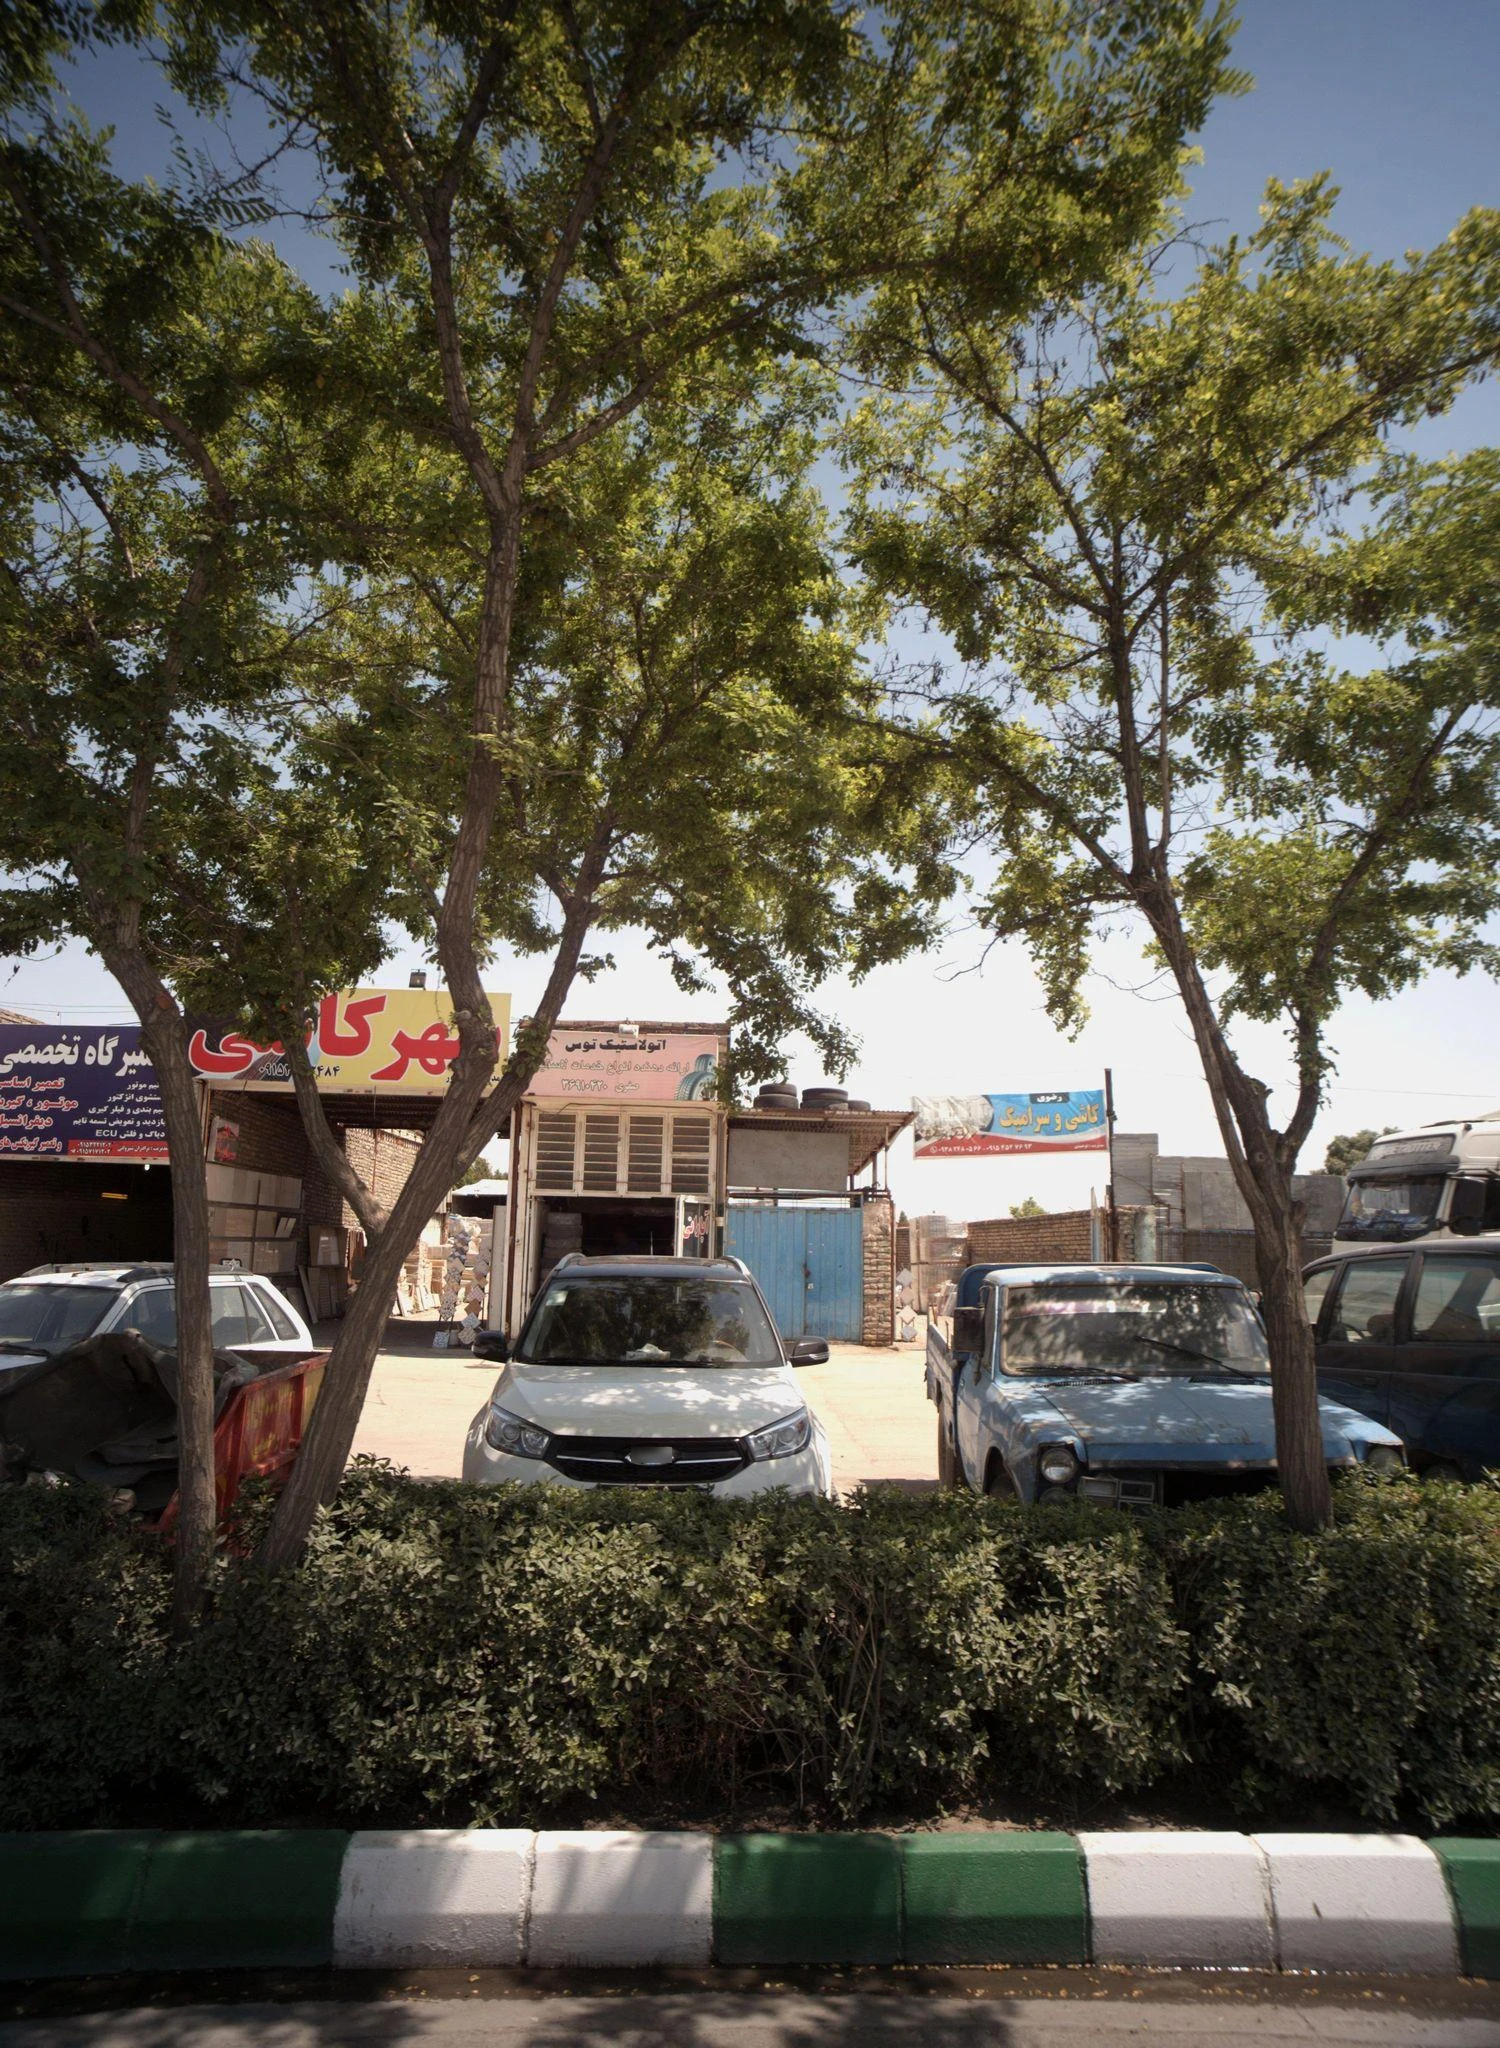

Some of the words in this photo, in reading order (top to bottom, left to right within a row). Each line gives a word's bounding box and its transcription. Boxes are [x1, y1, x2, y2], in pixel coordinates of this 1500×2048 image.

[0, 1033, 81, 1074] تخصصی
[370, 1021, 501, 1081] هر
[565, 1038, 596, 1053] توس
[31, 1077, 66, 1092] تعمیر
[1054, 1112, 1062, 1132] و
[95, 1129, 118, 1137] ECU
